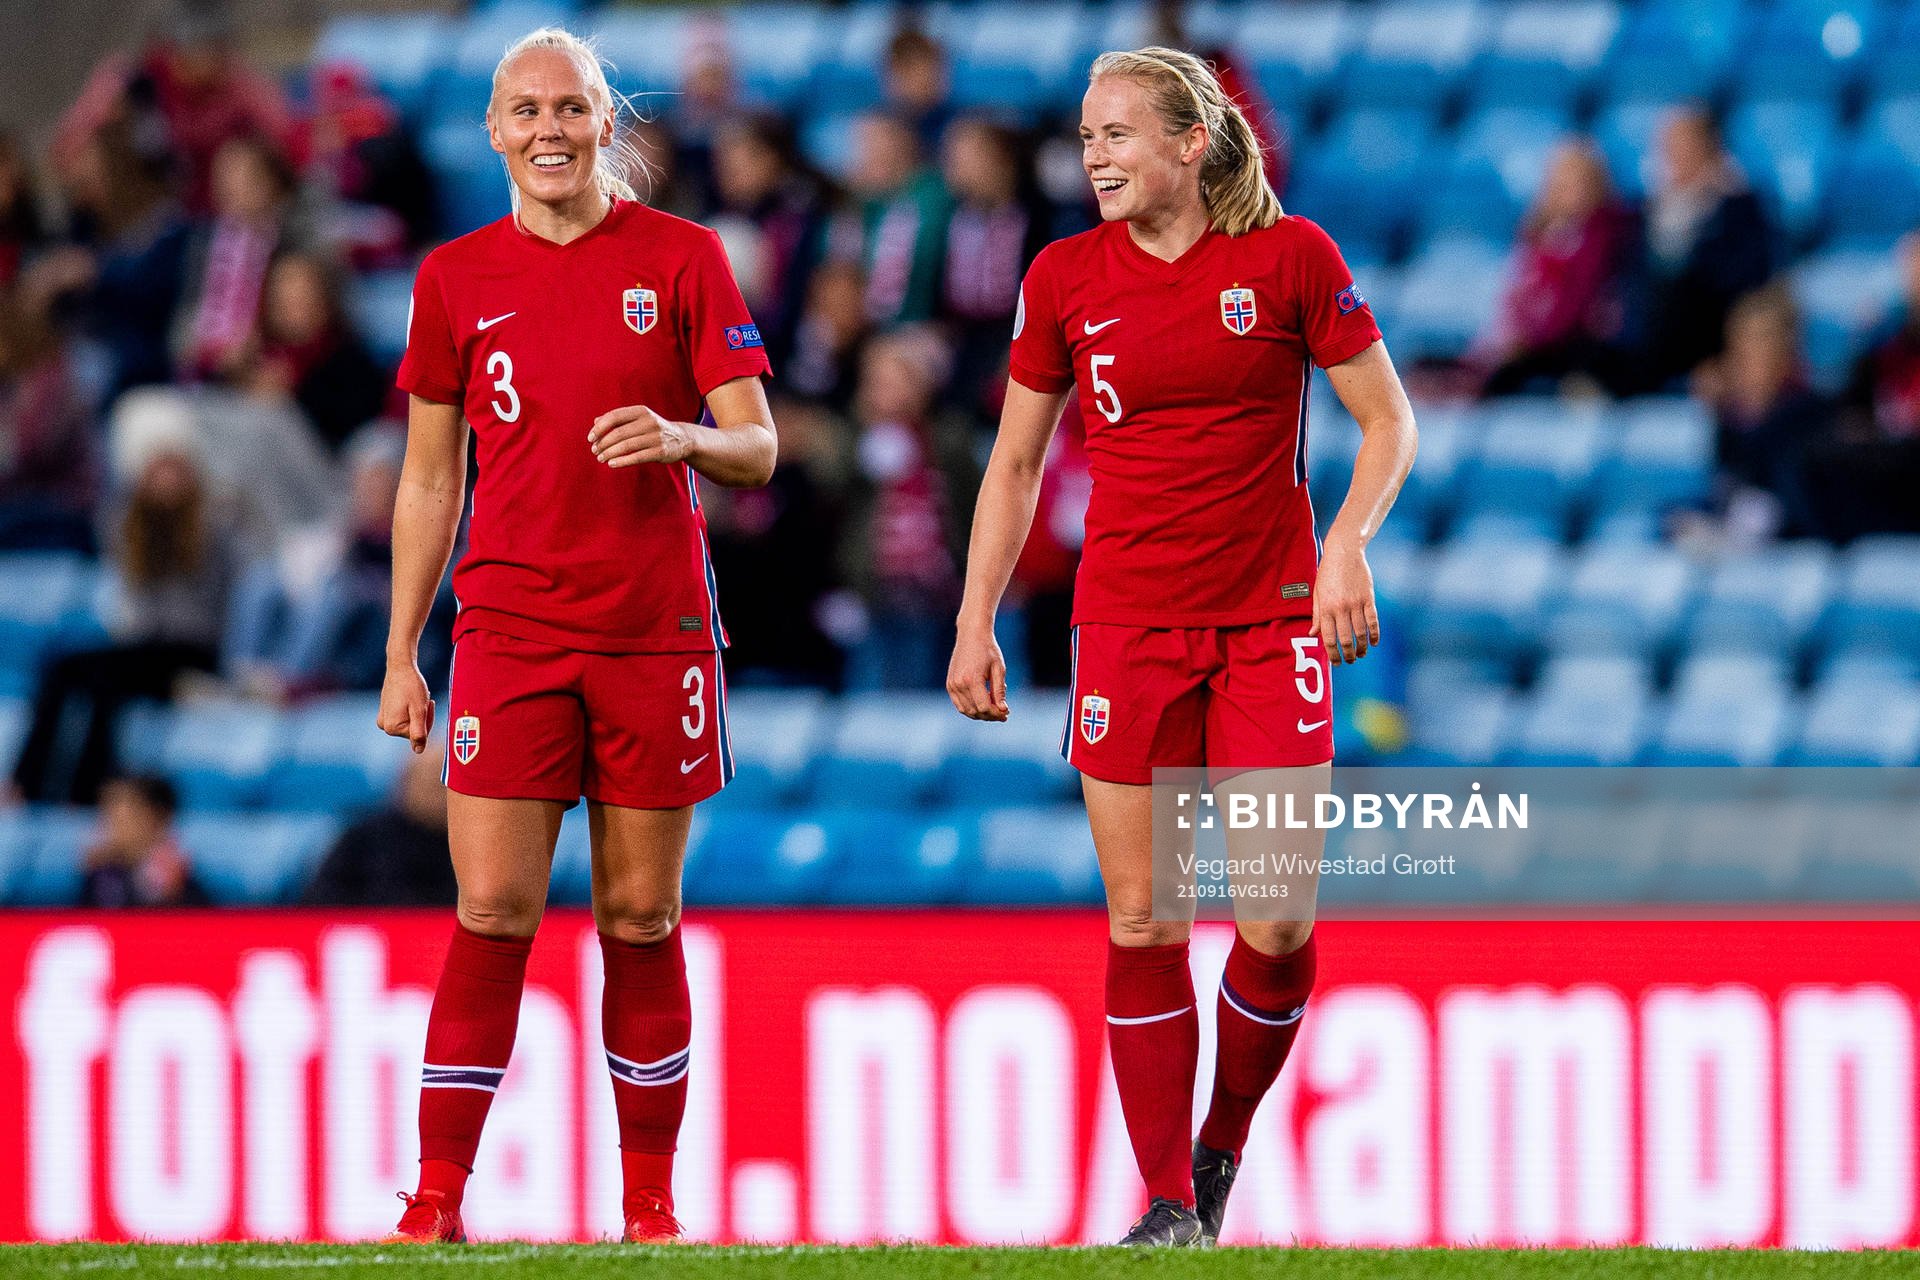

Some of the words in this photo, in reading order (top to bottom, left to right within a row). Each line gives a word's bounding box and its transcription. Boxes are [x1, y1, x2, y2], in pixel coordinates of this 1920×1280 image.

[486, 350, 521, 423] 3
[1090, 354, 1123, 424] 5
[681, 665, 706, 740] 3
[1290, 636, 1325, 704] 5
